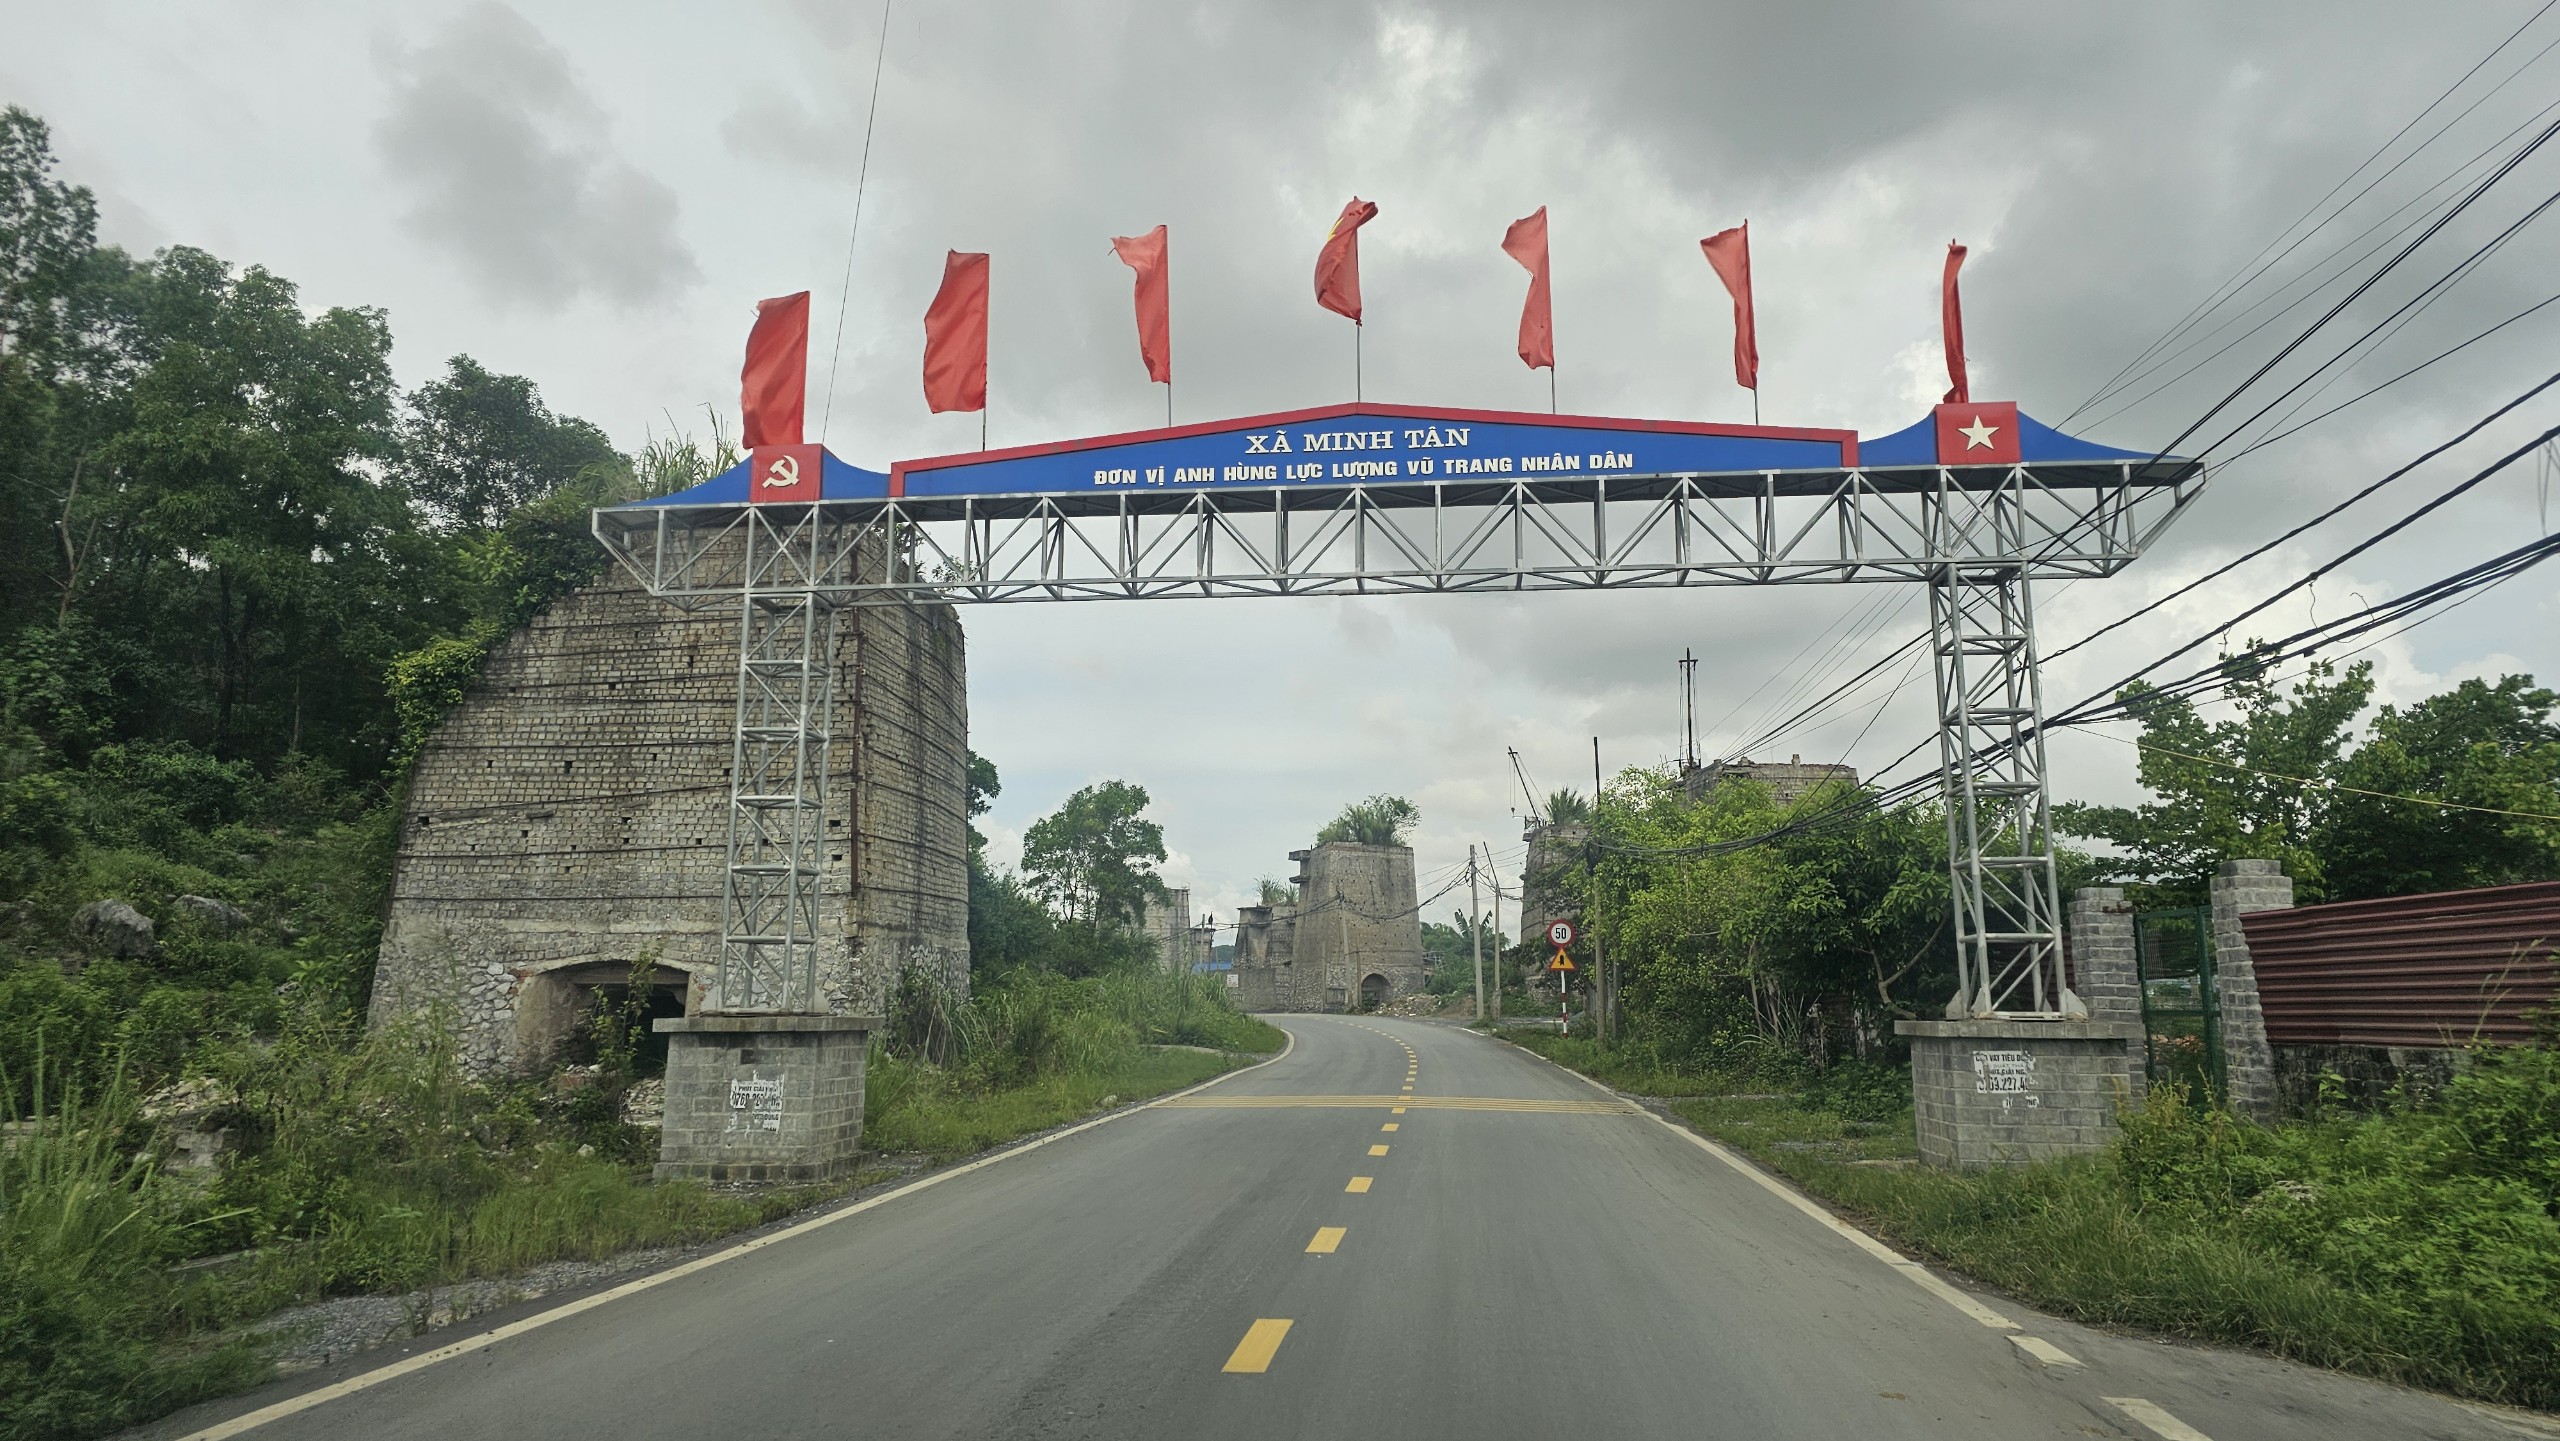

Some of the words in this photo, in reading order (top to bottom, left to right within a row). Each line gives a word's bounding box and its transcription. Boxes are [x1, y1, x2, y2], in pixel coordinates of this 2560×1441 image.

[1245, 430, 1293, 453] XÃ
[1303, 430, 1394, 452] MINH
[1404, 426, 1470, 449] TÂN
[1094, 469, 1137, 486] ĐƠN
[1145, 466, 1166, 487] VỊ
[1173, 467, 1215, 483] ANH
[1224, 462, 1277, 482] HÙNG
[1286, 463, 1323, 483] LỰC
[1332, 461, 1398, 480] LƯỢNG
[1407, 457, 1434, 475] VŨ
[1444, 457, 1513, 475] TRANG
[1521, 453, 1580, 471] NHÂN
[1589, 451, 1633, 470] DÂN
[1555, 927, 1567, 939] 50
